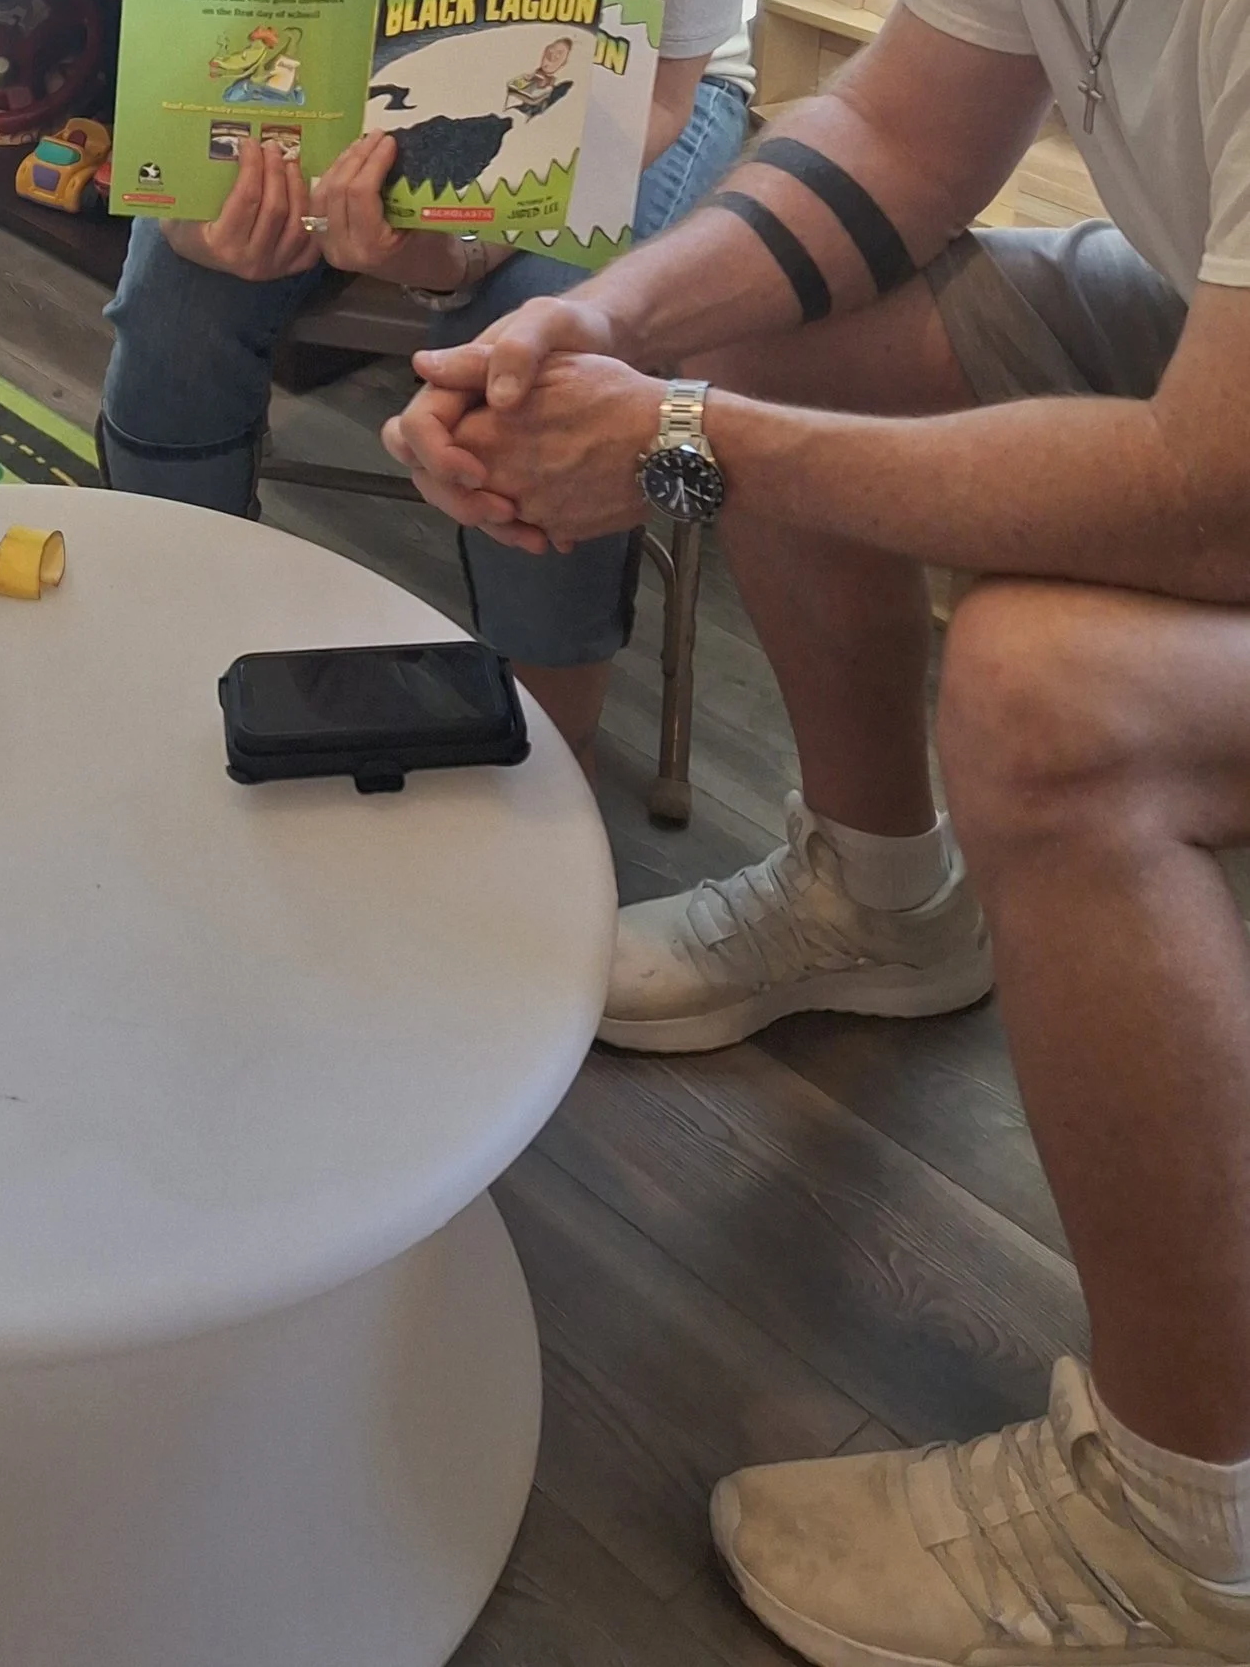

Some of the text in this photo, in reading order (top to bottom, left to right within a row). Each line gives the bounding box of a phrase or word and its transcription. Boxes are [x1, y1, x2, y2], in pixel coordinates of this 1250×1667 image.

[216, 7, 232, 16] the
[234, 8, 254, 17] first
[256, 10, 273, 20] day
[275, 10, 286, 18] of
[431, 208, 494, 219] SCHOLASTIC
